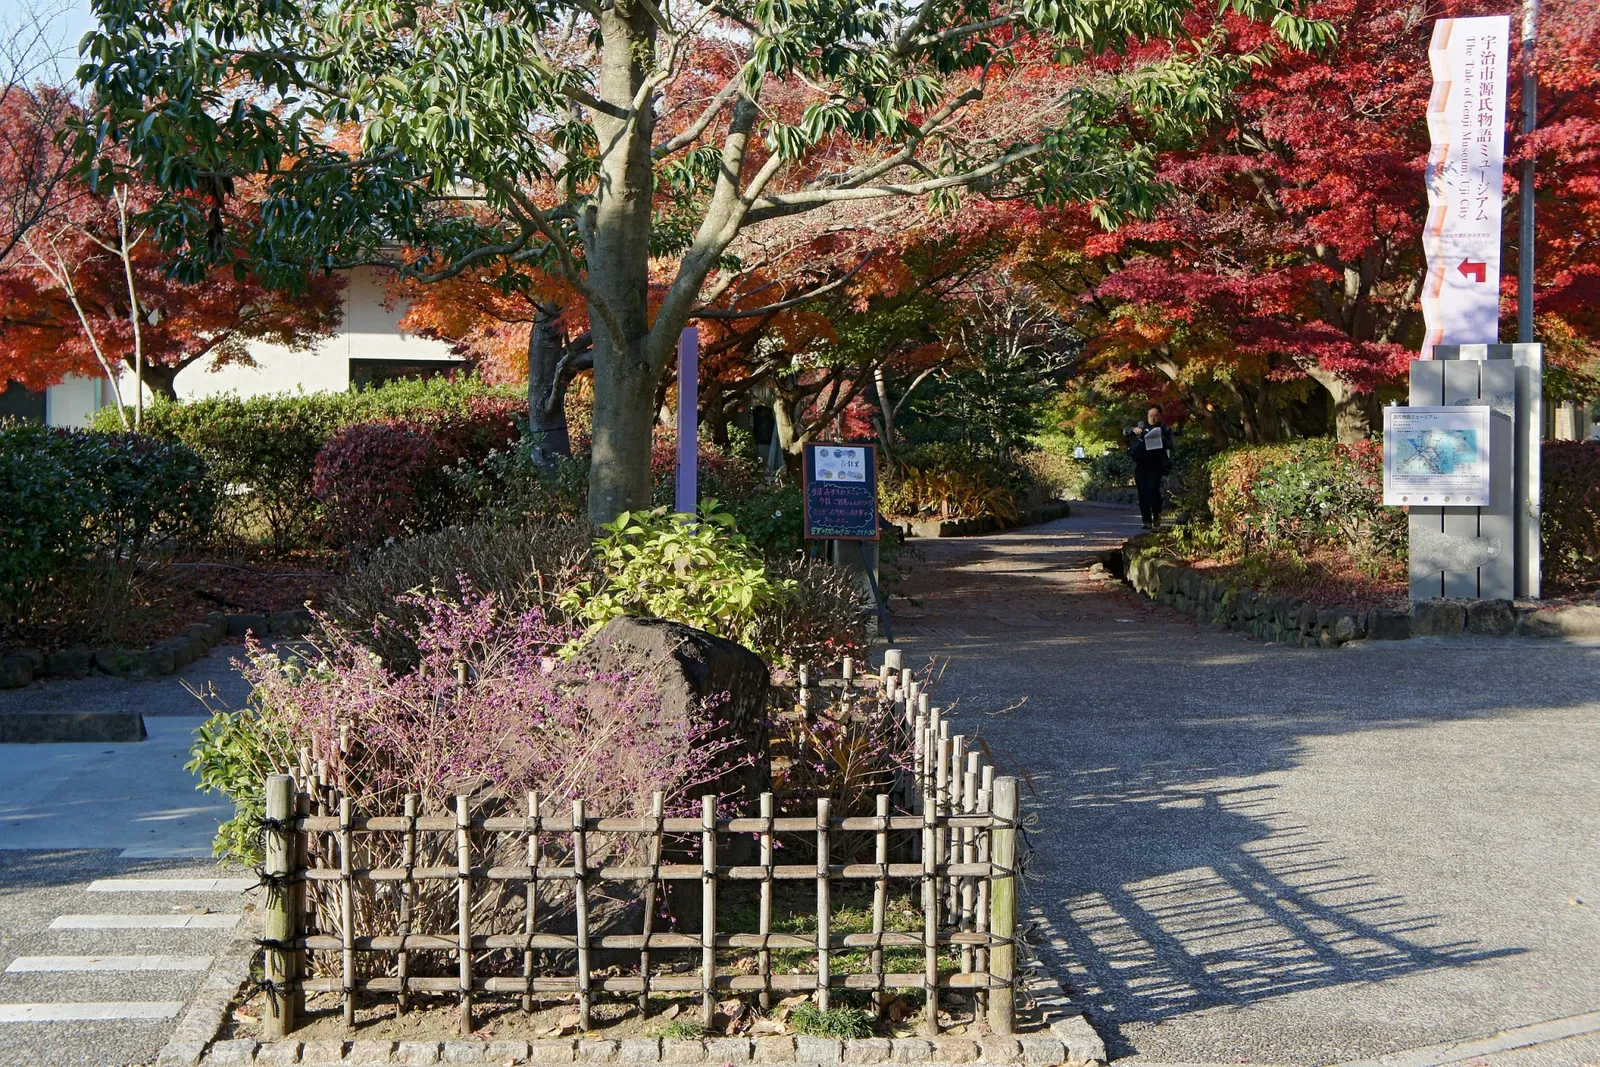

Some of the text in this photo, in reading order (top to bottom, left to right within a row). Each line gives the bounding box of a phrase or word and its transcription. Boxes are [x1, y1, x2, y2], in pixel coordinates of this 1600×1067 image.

[1458, 36, 1476, 221] The Tale of Genji Museum, Uji City
[1475, 34, 1497, 221] 宇治市源氏物語ミュージアム
